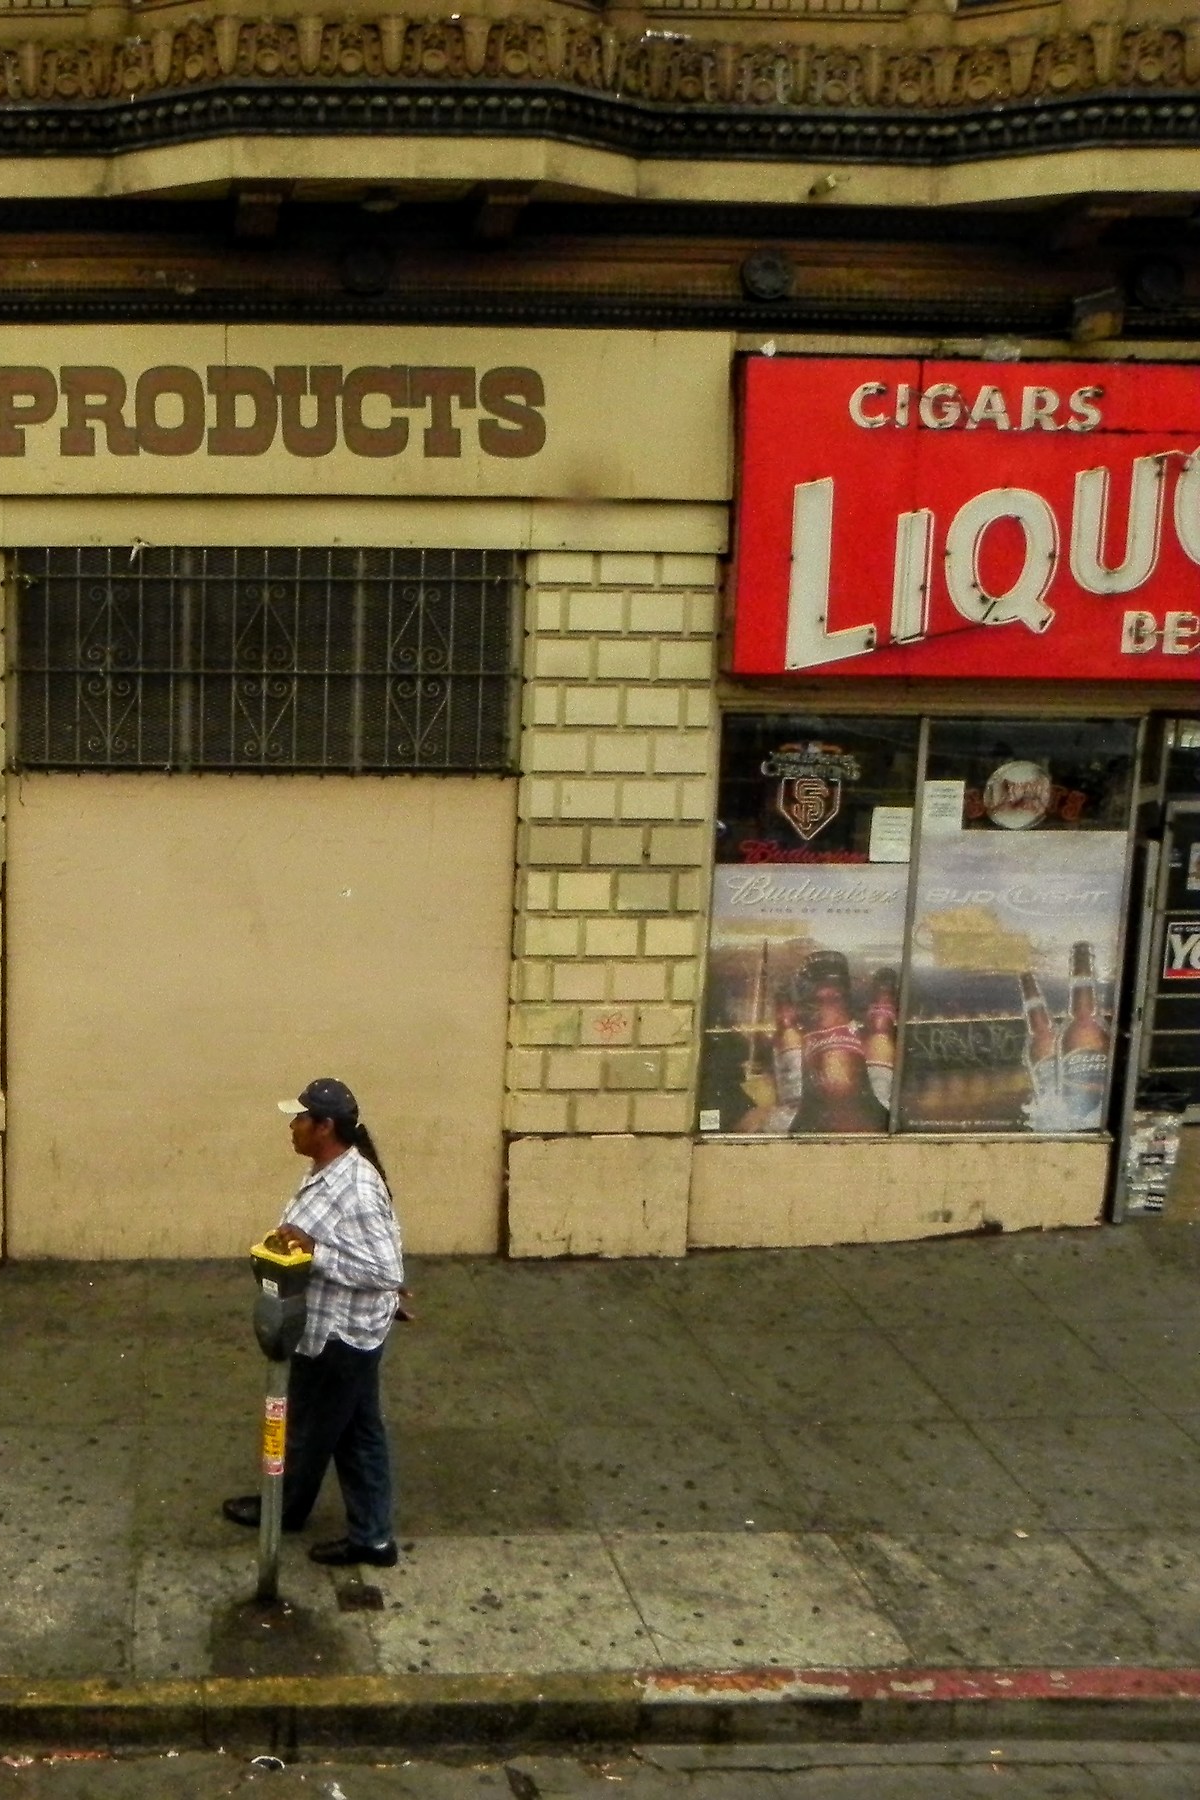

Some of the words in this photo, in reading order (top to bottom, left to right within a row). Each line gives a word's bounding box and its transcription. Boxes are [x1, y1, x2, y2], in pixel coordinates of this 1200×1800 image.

[848, 381, 1105, 432] CIGARS
[785, 445, 1200, 670] LIQU
[726, 874, 898, 906] Budweiser
